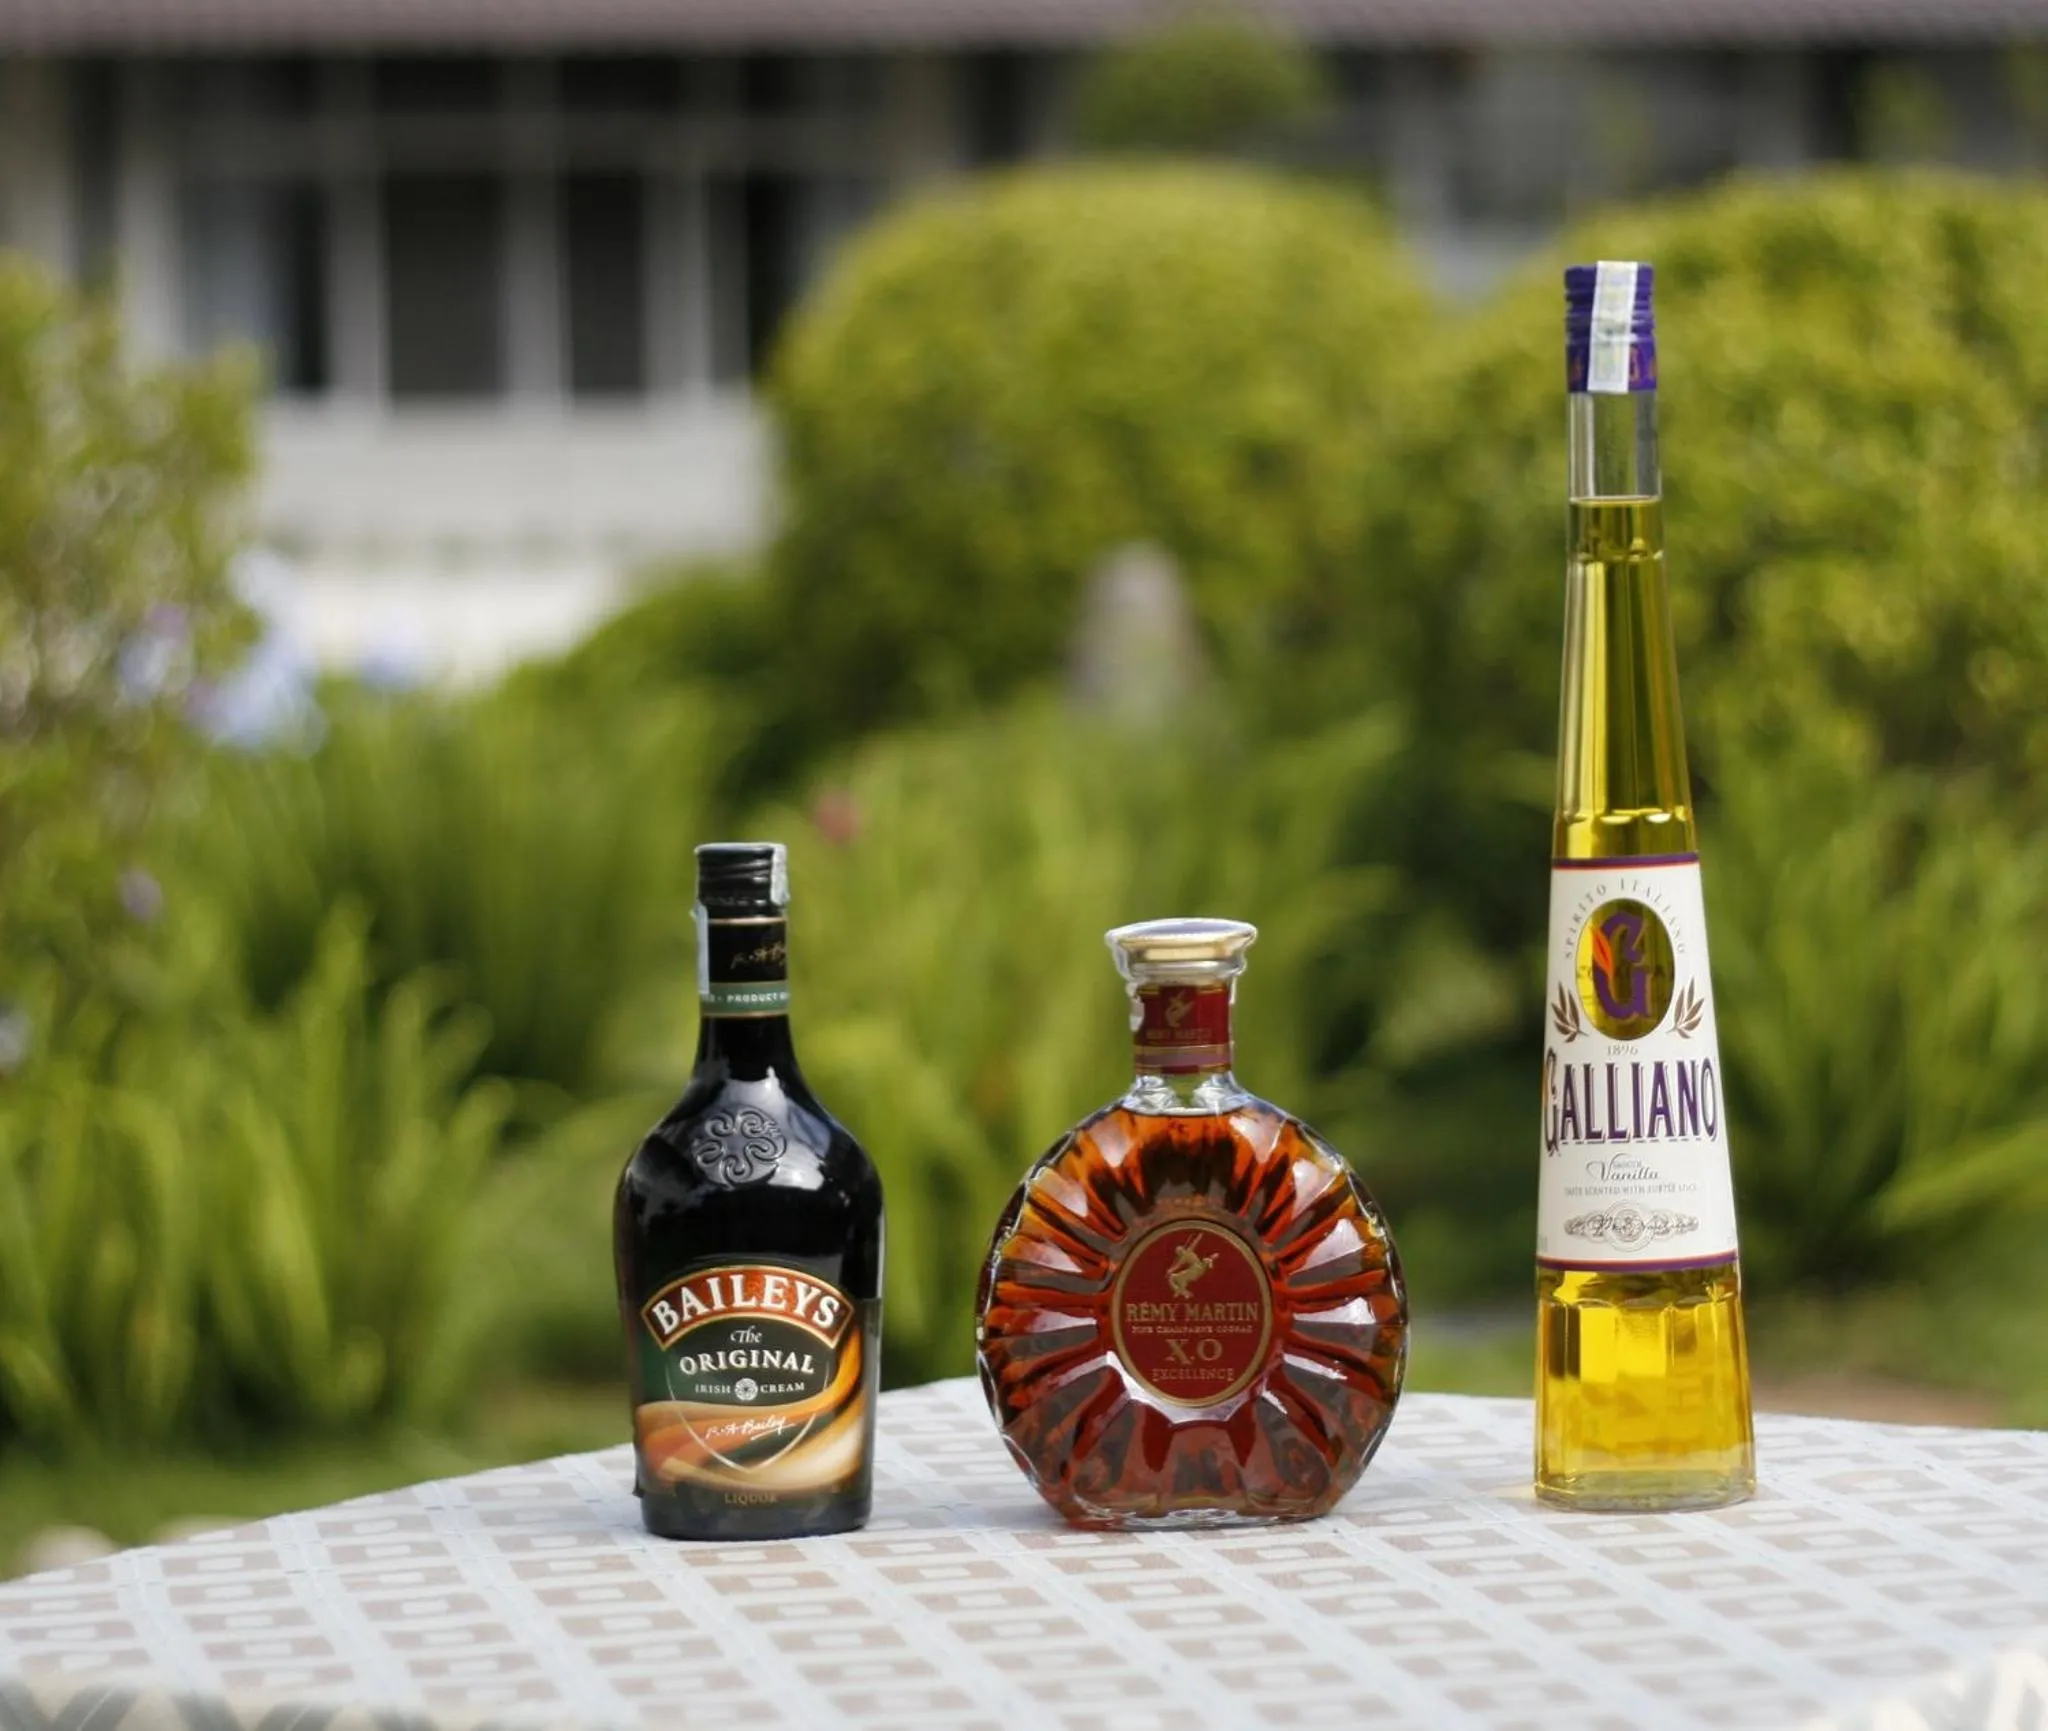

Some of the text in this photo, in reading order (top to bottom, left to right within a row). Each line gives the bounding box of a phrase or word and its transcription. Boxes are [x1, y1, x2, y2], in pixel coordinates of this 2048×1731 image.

[1564, 878, 1685, 958] SPIRITO ITALIANO
[726, 993, 777, 1004] PRODUCT
[1543, 1047, 1718, 1157] GALLIANO
[1586, 1153, 1658, 1180] Vanilla
[651, 1273, 840, 1335] BAILEYS
[1126, 1301, 1259, 1322] RÉMY MARTIN
[729, 1325, 763, 1344] The
[679, 1350, 815, 1375] ORIGINAL
[1151, 1367, 1235, 1382] EXCELLENCE
[694, 1381, 805, 1394] IRISH CREAM
[723, 1492, 778, 1505] LIQUOR
